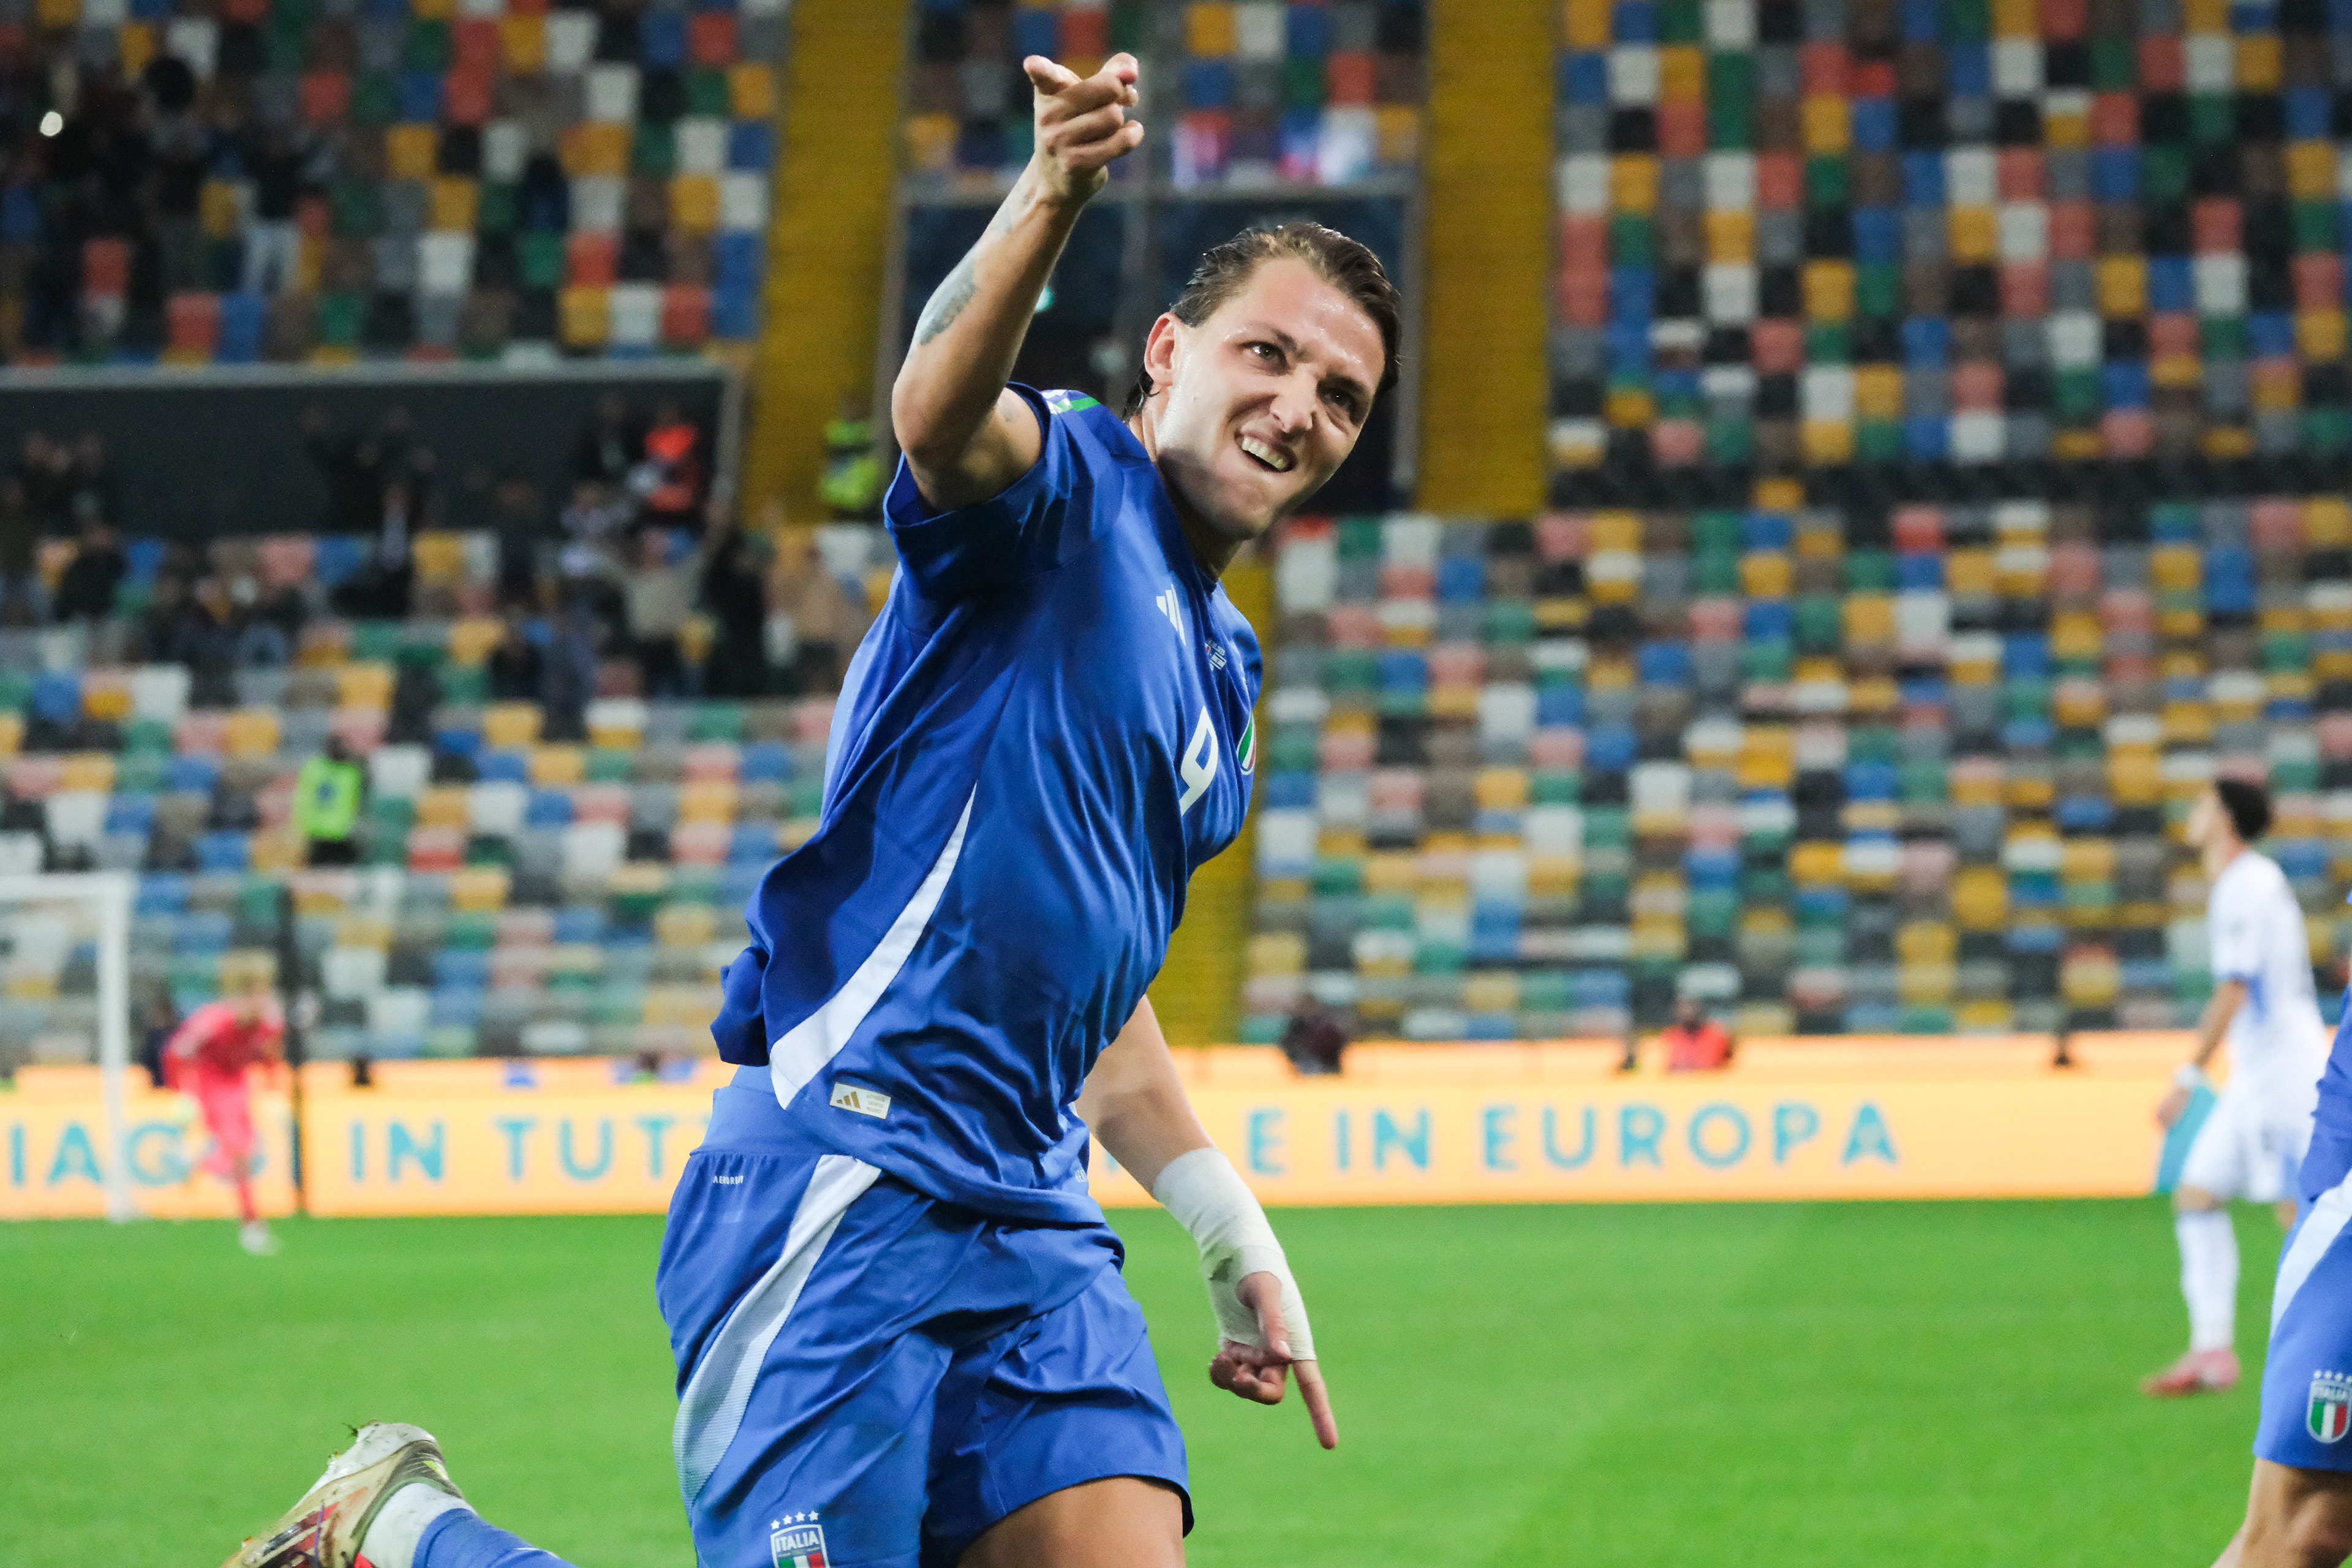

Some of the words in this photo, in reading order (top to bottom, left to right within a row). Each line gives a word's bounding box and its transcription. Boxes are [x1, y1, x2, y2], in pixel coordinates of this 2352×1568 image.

[1179, 705, 1219, 817] 9
[350, 1120, 447, 1183] IN
[494, 1114, 712, 1181] TUT
[1245, 1109, 1283, 1174] E
[1335, 1109, 1431, 1170] IN
[1481, 1101, 1898, 1169] EUROPA
[775, 1531, 820, 1552] ITALIA
